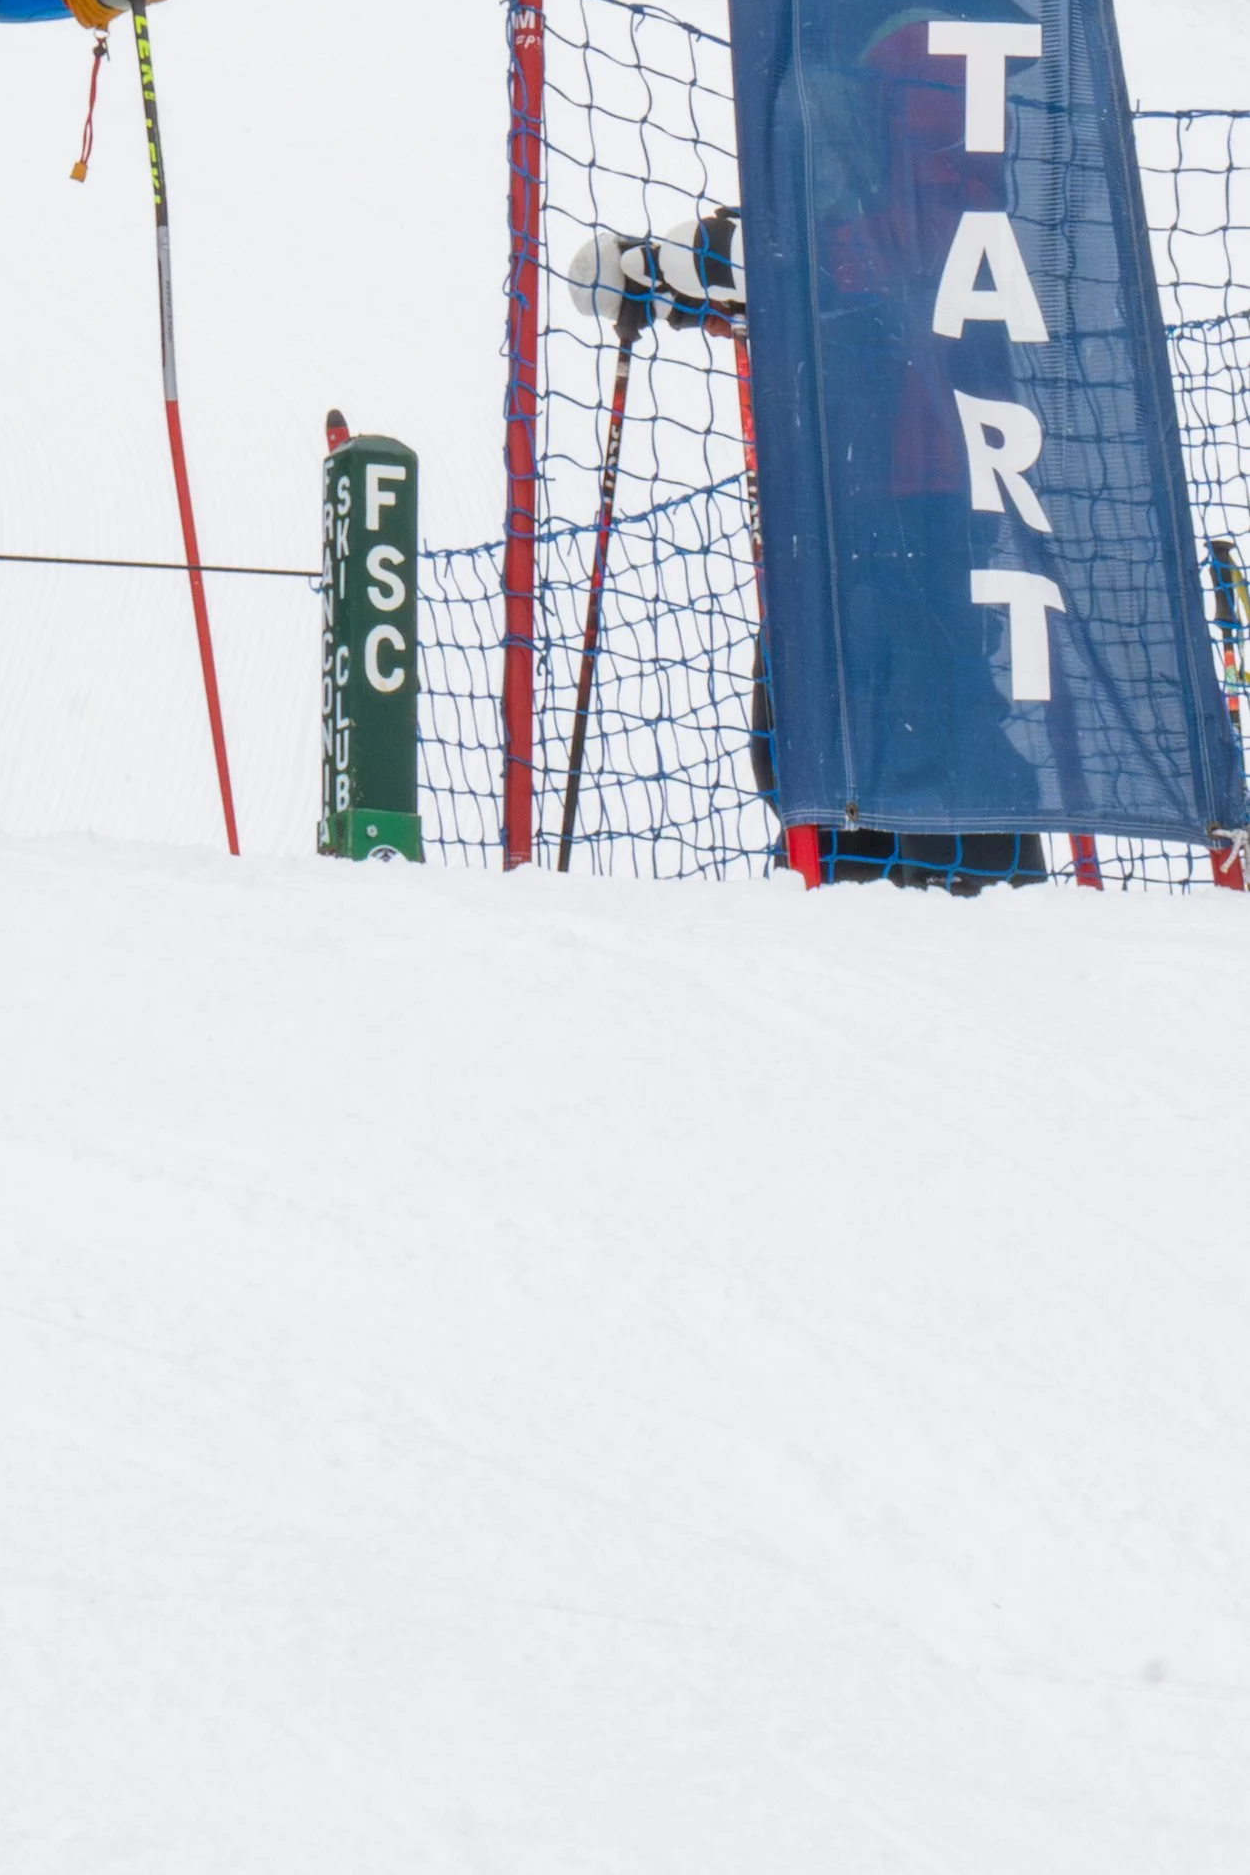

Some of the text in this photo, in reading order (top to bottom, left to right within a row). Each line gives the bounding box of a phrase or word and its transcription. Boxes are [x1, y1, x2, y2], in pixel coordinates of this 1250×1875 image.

[336, 475, 350, 813] SKI CLUB
[365, 463, 407, 693] FSC
